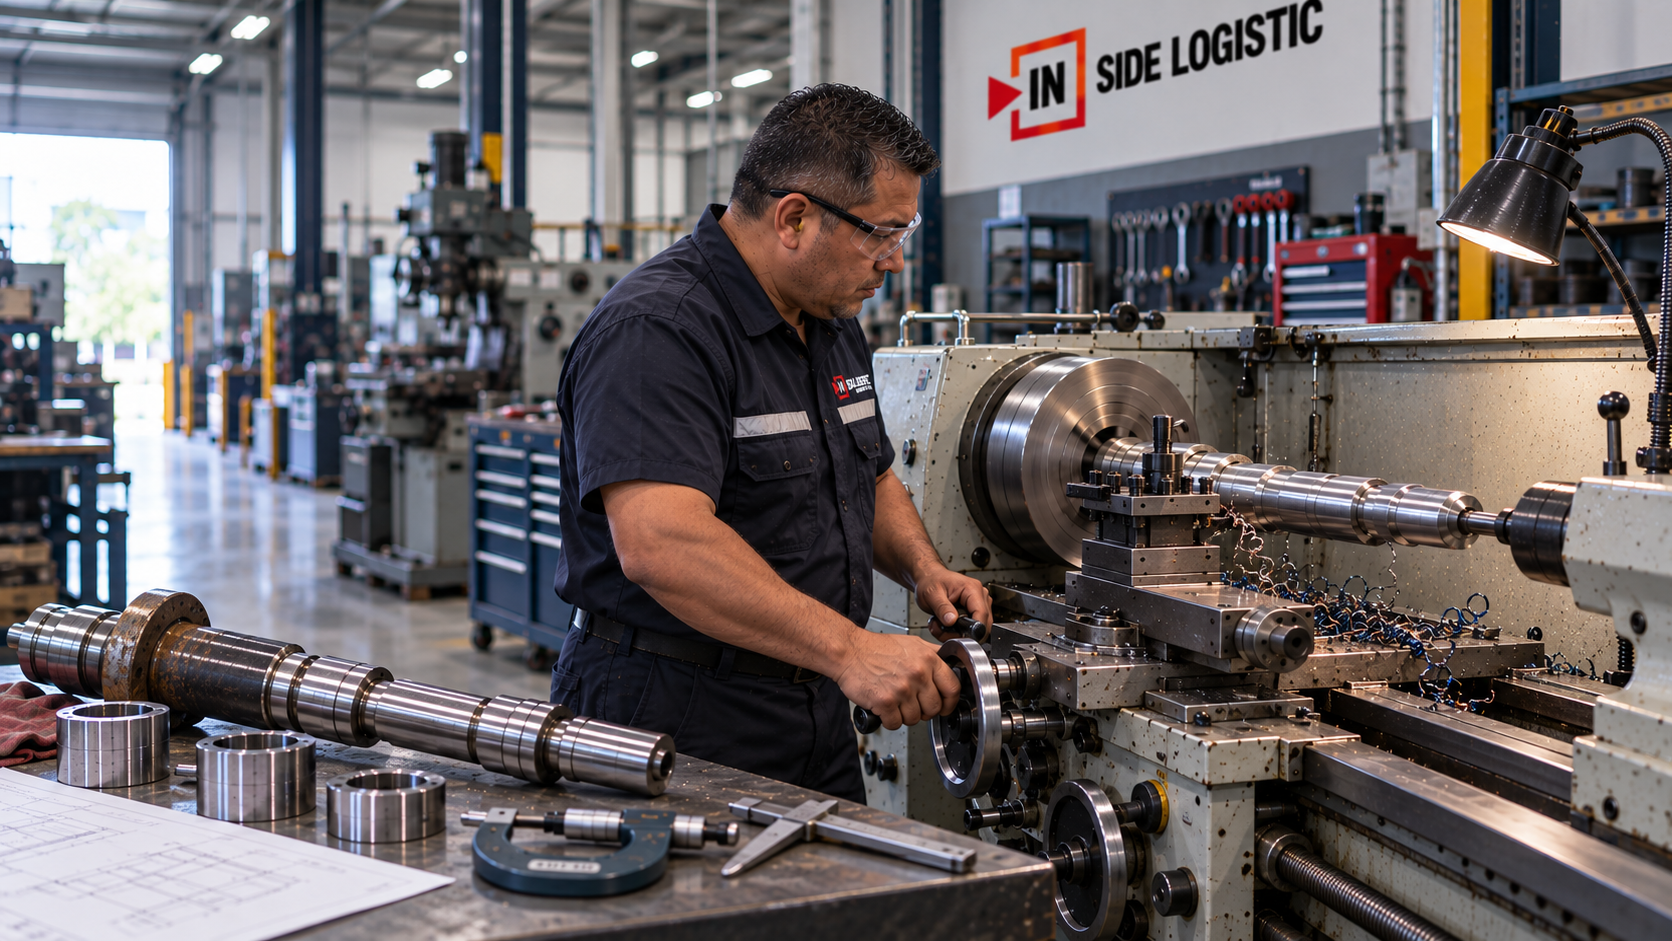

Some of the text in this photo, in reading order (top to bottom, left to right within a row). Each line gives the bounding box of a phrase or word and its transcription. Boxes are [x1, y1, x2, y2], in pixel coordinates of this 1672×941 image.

[1029, 0, 1323, 111] IN SIDE LOGISTIC
